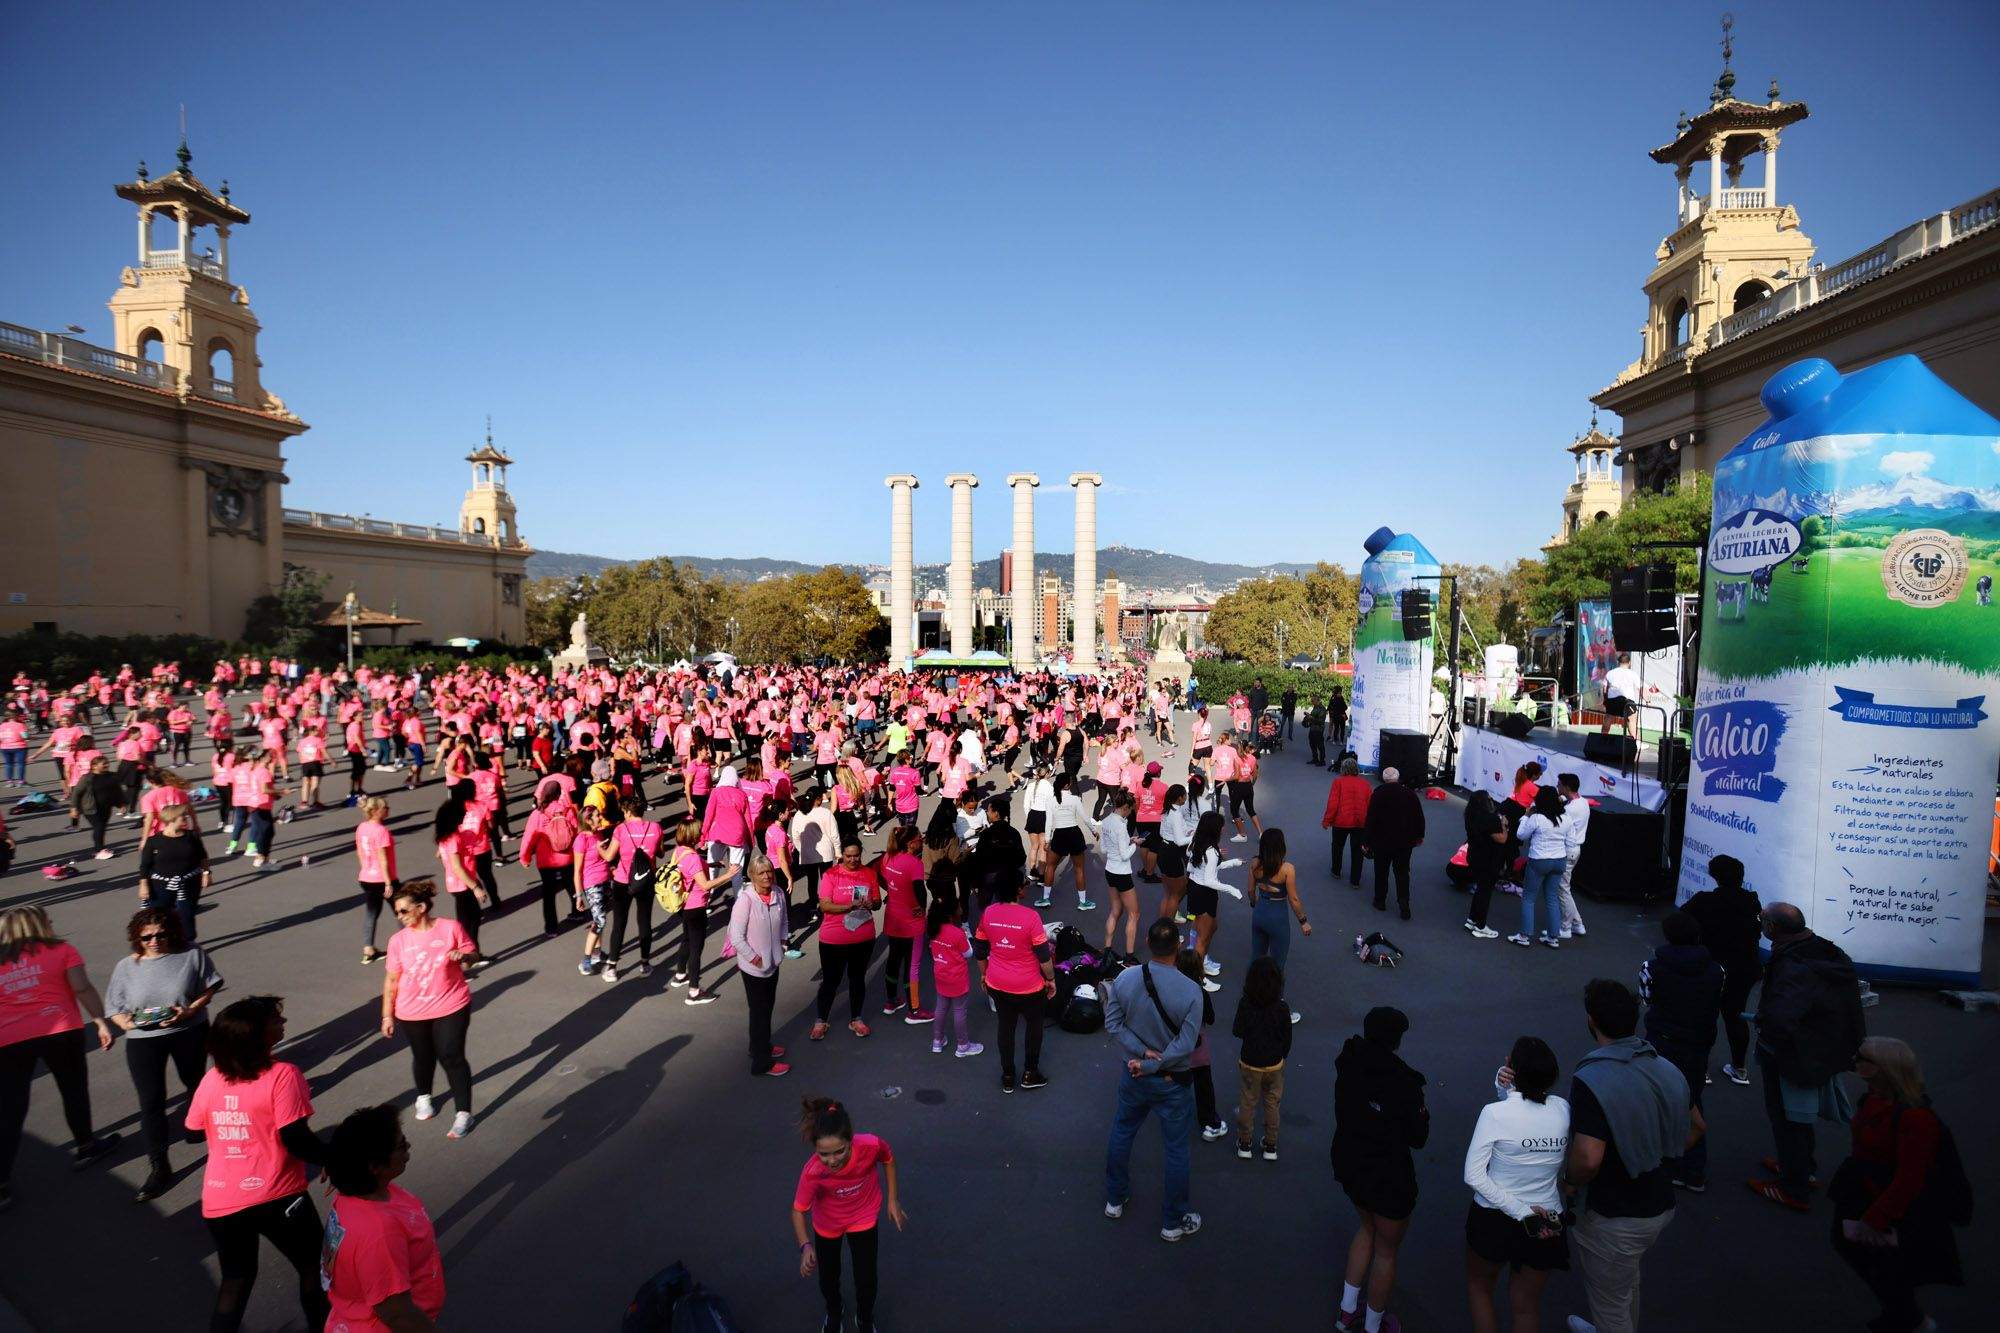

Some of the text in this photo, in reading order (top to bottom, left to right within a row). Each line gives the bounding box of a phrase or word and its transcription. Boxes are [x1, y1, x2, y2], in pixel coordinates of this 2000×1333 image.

[1723, 527, 1788, 541] CENTRAL LECHERA
[1711, 536, 1791, 562] ASTURIANA
[1905, 572, 1927, 589] Desde
[1896, 583, 1920, 601] LECHE
[1715, 686, 1731, 700] rica
[1734, 686, 1746, 698] en
[1848, 705, 1975, 725] COMPROMETIDOS CON LO NATURAL
[1695, 711, 1768, 761] Calcio
[1873, 754, 1944, 768] Ingredientes
[1715, 771, 1762, 792] natural
[1882, 767, 1933, 780] naturales
[1832, 781, 1974, 798] Esta leche con calcio se elabora
[1852, 795, 1893, 806] mediante
[1908, 801, 1943, 810] proceso
[1945, 801, 1955, 810] de
[1690, 802, 1757, 834] semidesnatada
[1847, 818, 1856, 828] el
[1858, 820, 1903, 832] contenido
[1905, 823, 1916, 832] de
[1875, 811, 1890, 821] que
[1892, 811, 1927, 823] permite
[1929, 814, 1968, 823] aumentar
[1838, 832, 1881, 845] conseguir
[1884, 835, 1899, 844] así
[1911, 836, 1942, 848] aporte
[1944, 839, 1968, 848] extra
[1835, 843, 1847, 852] de
[1849, 844, 1875, 855] calcio
[1877, 846, 1910, 857] natural
[1926, 850, 1933, 859] la
[1936, 850, 1960, 860] leche.
[1849, 884, 1940, 902] Porque lo natural,
[1852, 898, 1933, 912] natural te sabe
[1857, 910, 1870, 919] te
[1872, 912, 1904, 923] sienta
[1908, 914, 1939, 927] mejor.
[224, 1095, 239, 1110] TU
[212, 1111, 252, 1125] DORSAL
[217, 1126, 250, 1140] SUMA
